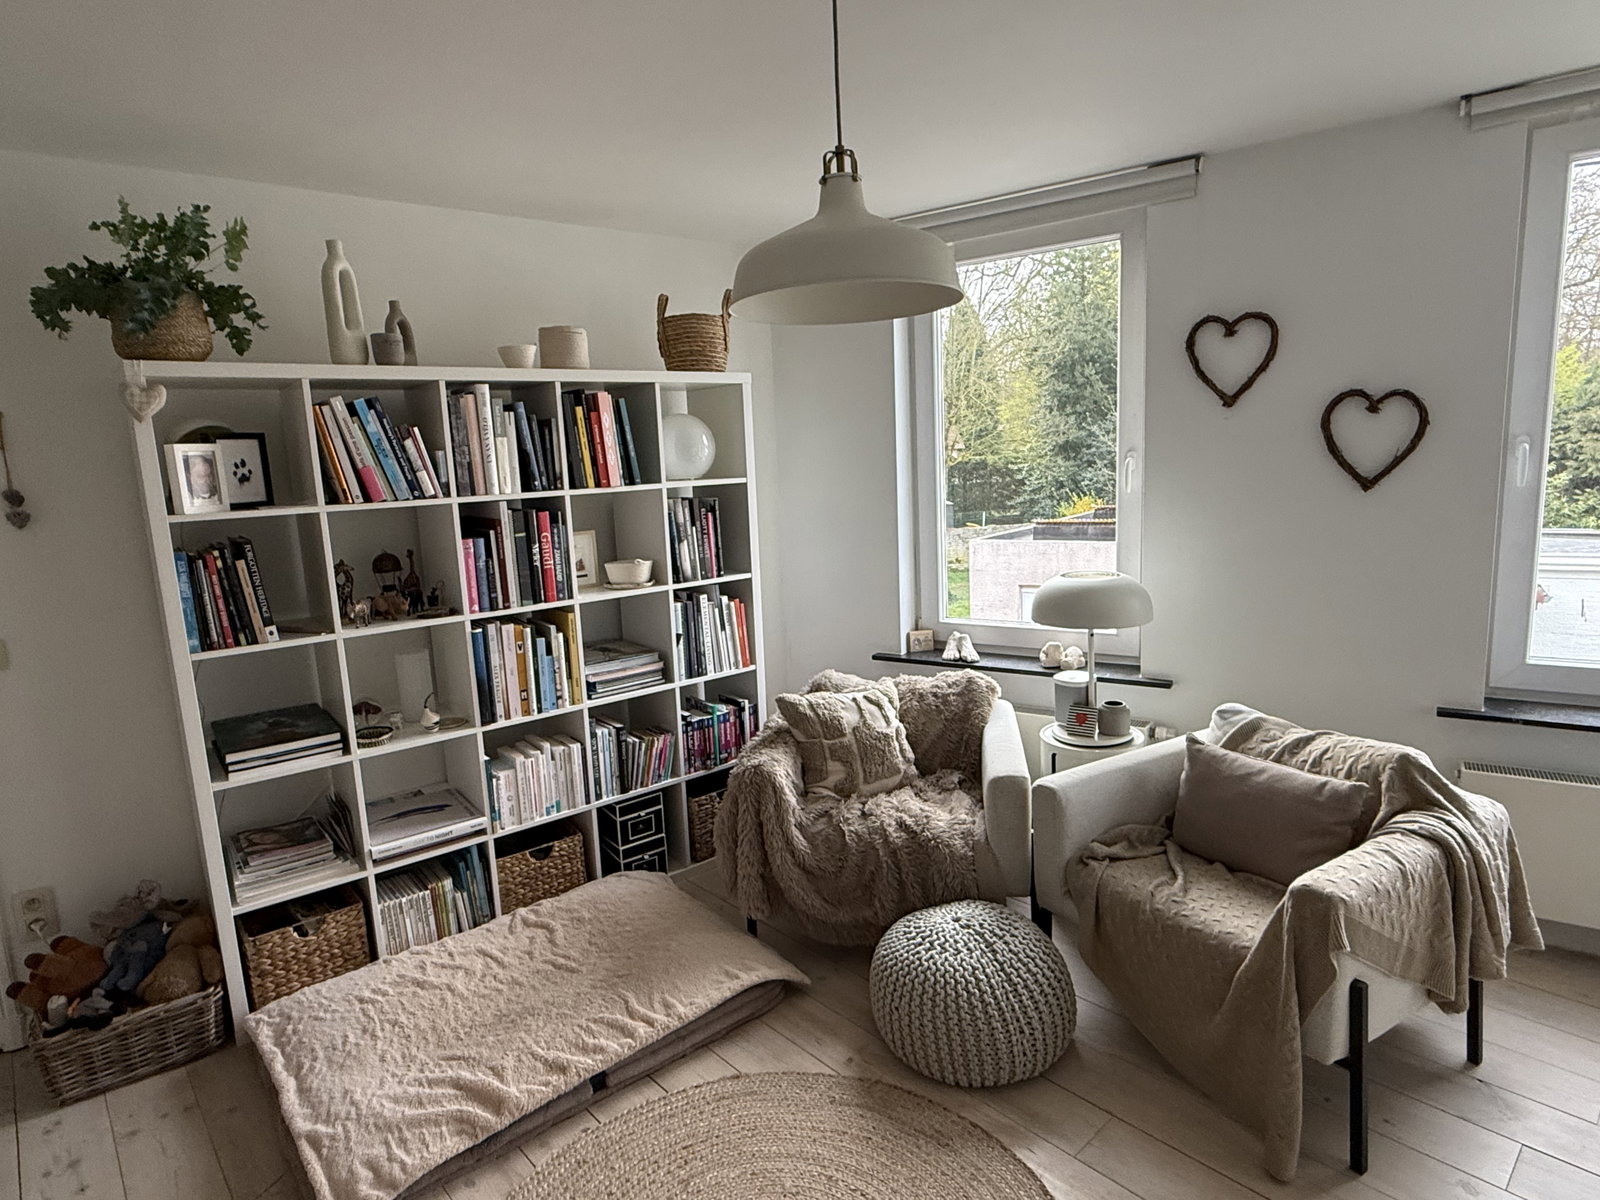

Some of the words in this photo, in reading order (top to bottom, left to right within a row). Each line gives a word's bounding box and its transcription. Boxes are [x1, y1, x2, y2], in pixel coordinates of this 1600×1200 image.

[391, 439, 402, 457] Portraits
[402, 465, 412, 480] People
[244, 544, 260, 586] FORGOTTEN
[256, 586, 270, 618] HERITAGE
[701, 596, 710, 638] ELEMENTAL
[494, 680, 502, 703] PRAGER
[434, 829, 453, 838] NIGHT
